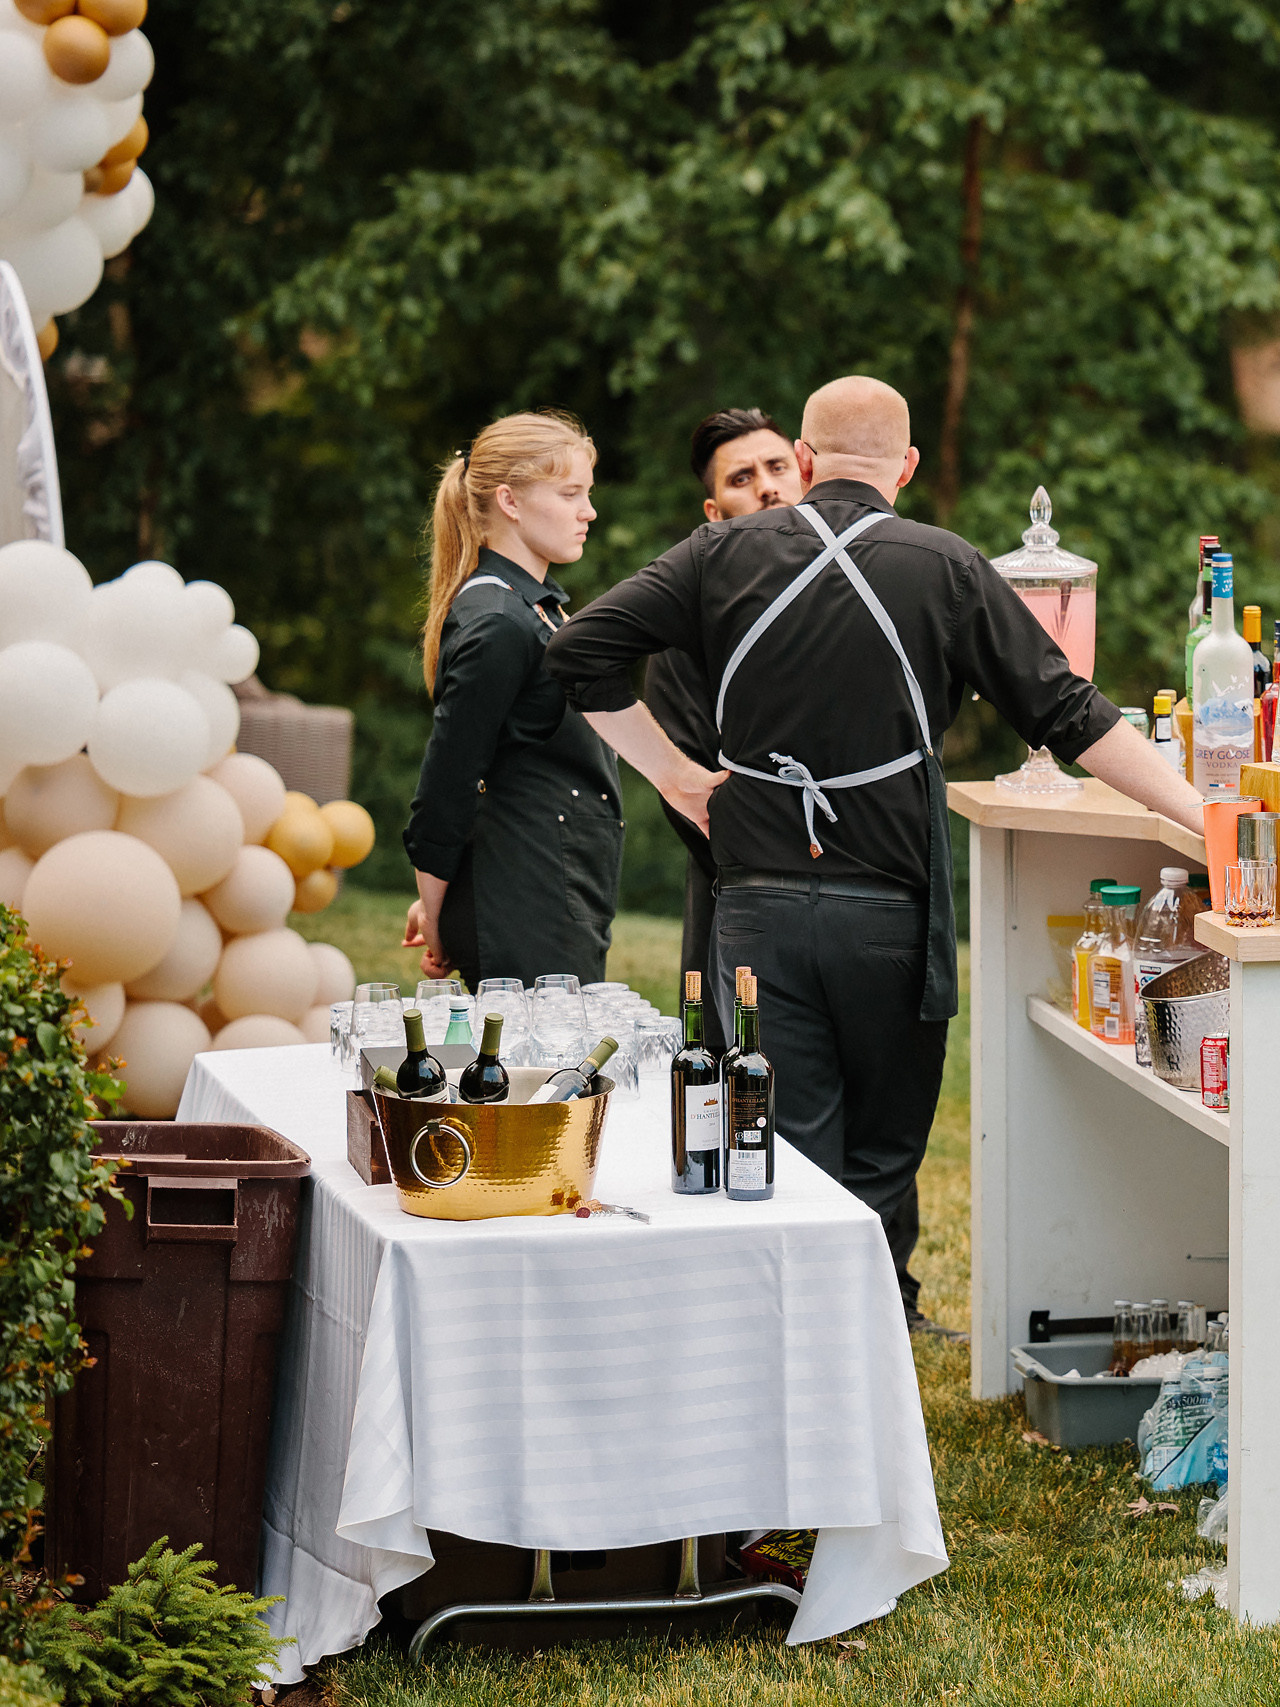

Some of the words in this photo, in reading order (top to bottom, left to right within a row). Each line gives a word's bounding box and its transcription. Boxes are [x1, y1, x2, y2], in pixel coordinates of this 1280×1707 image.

[1195, 748, 1214, 760] GREY
[1217, 749, 1250, 760] GOOSE
[755, 1544, 808, 1567] ZOMBIE
